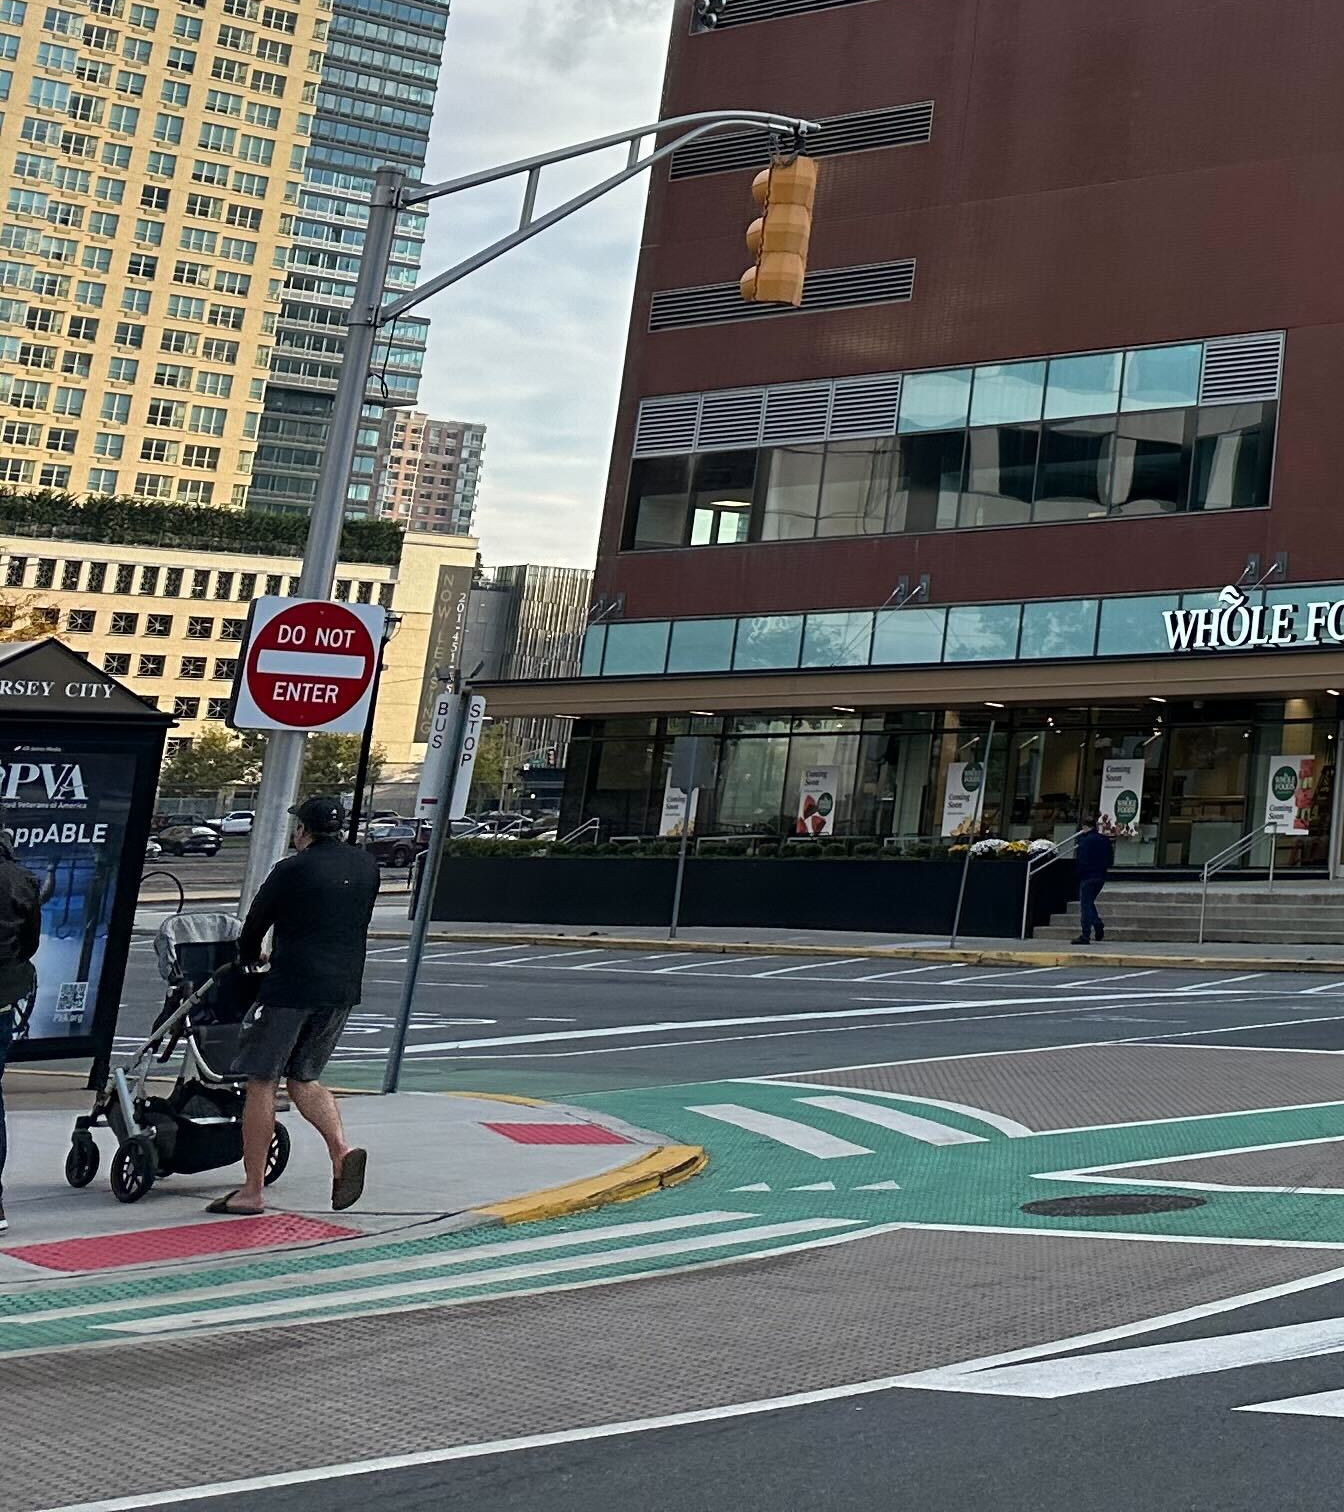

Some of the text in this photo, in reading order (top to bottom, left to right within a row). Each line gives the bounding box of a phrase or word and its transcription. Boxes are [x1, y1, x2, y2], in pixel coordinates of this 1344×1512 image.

[1161, 584, 1293, 651] WHOLE
[277, 624, 356, 648] DO NOT
[65, 682, 116, 698] CITY
[272, 681, 339, 703] ENTER
[432, 701, 449, 749] BUS
[461, 703, 481, 767] STOP
[1, 763, 89, 800] PVA
[1105, 765, 1131, 775] Coming
[1105, 774, 1122, 782] Soon
